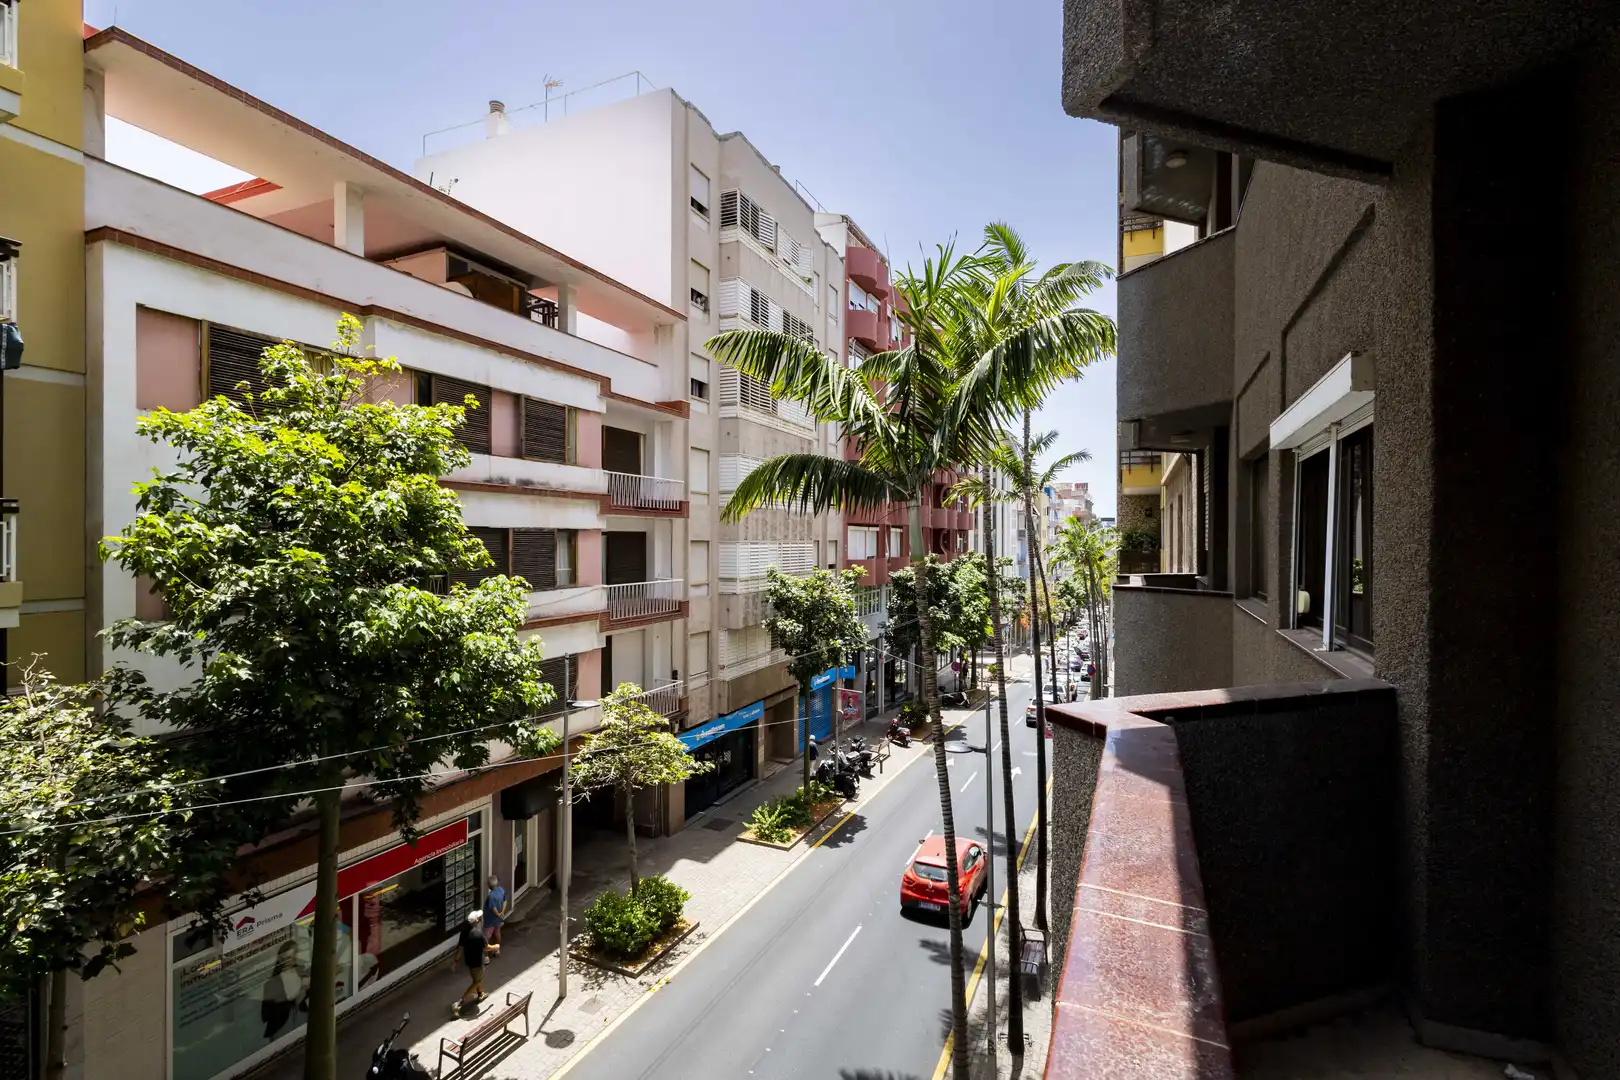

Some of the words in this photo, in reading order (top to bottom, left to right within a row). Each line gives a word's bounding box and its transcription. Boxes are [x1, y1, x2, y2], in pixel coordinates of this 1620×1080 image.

[413, 851, 436, 865] Agencia
[236, 925, 254, 937] ERA
[256, 912, 283, 928] Prisma
